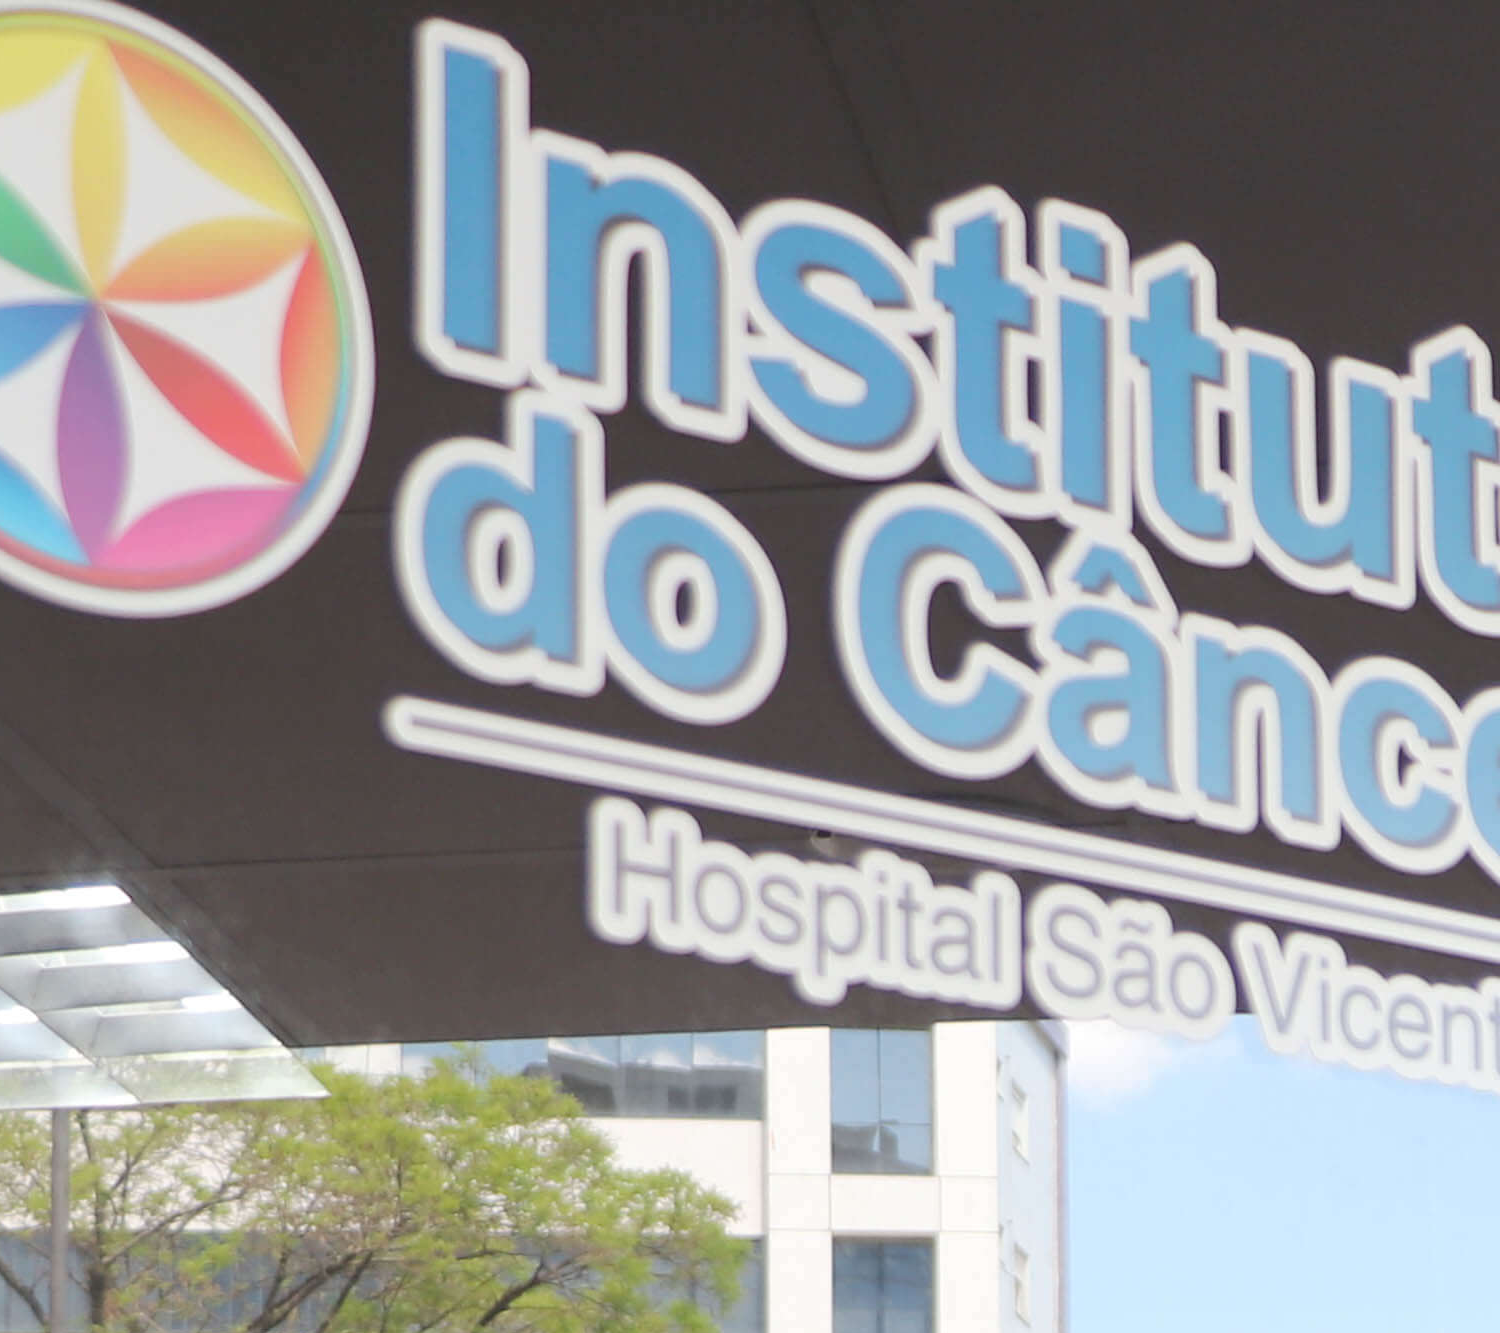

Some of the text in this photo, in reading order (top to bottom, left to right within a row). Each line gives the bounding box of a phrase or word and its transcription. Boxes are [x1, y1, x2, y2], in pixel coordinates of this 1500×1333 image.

[416, 408, 766, 698] do
[608, 826, 1008, 986] Hospital
[1040, 898, 1224, 1026] São
